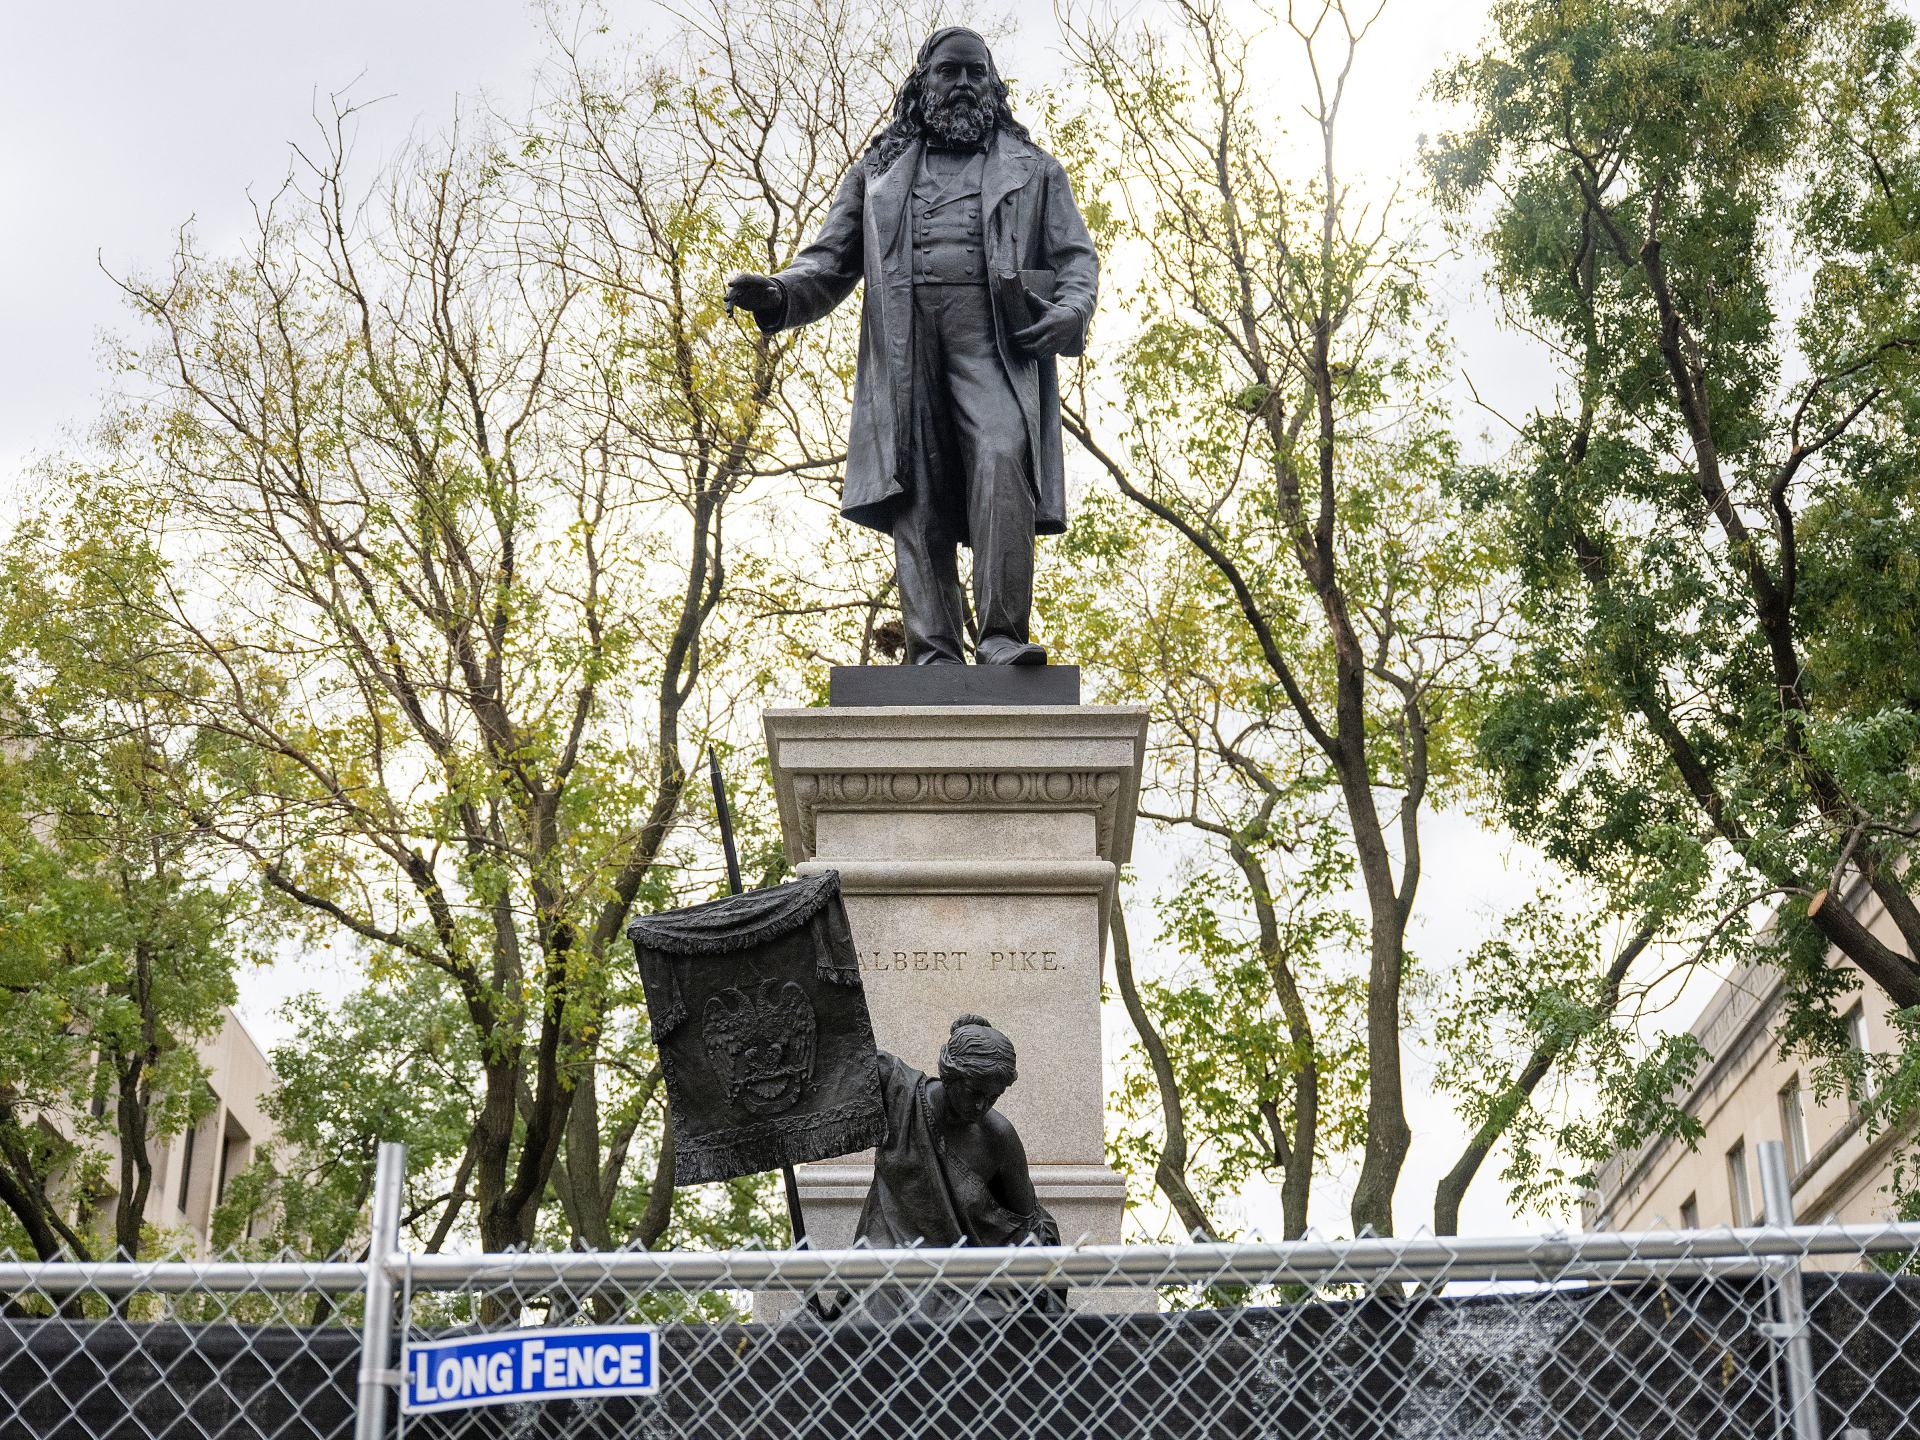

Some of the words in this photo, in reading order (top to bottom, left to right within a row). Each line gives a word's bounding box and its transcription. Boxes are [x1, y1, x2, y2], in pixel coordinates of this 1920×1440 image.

[858, 951, 967, 971] ALBERT
[989, 951, 1065, 971] PIKE.
[416, 1351, 514, 1402] LONG
[521, 1339, 645, 1390] FENCE
